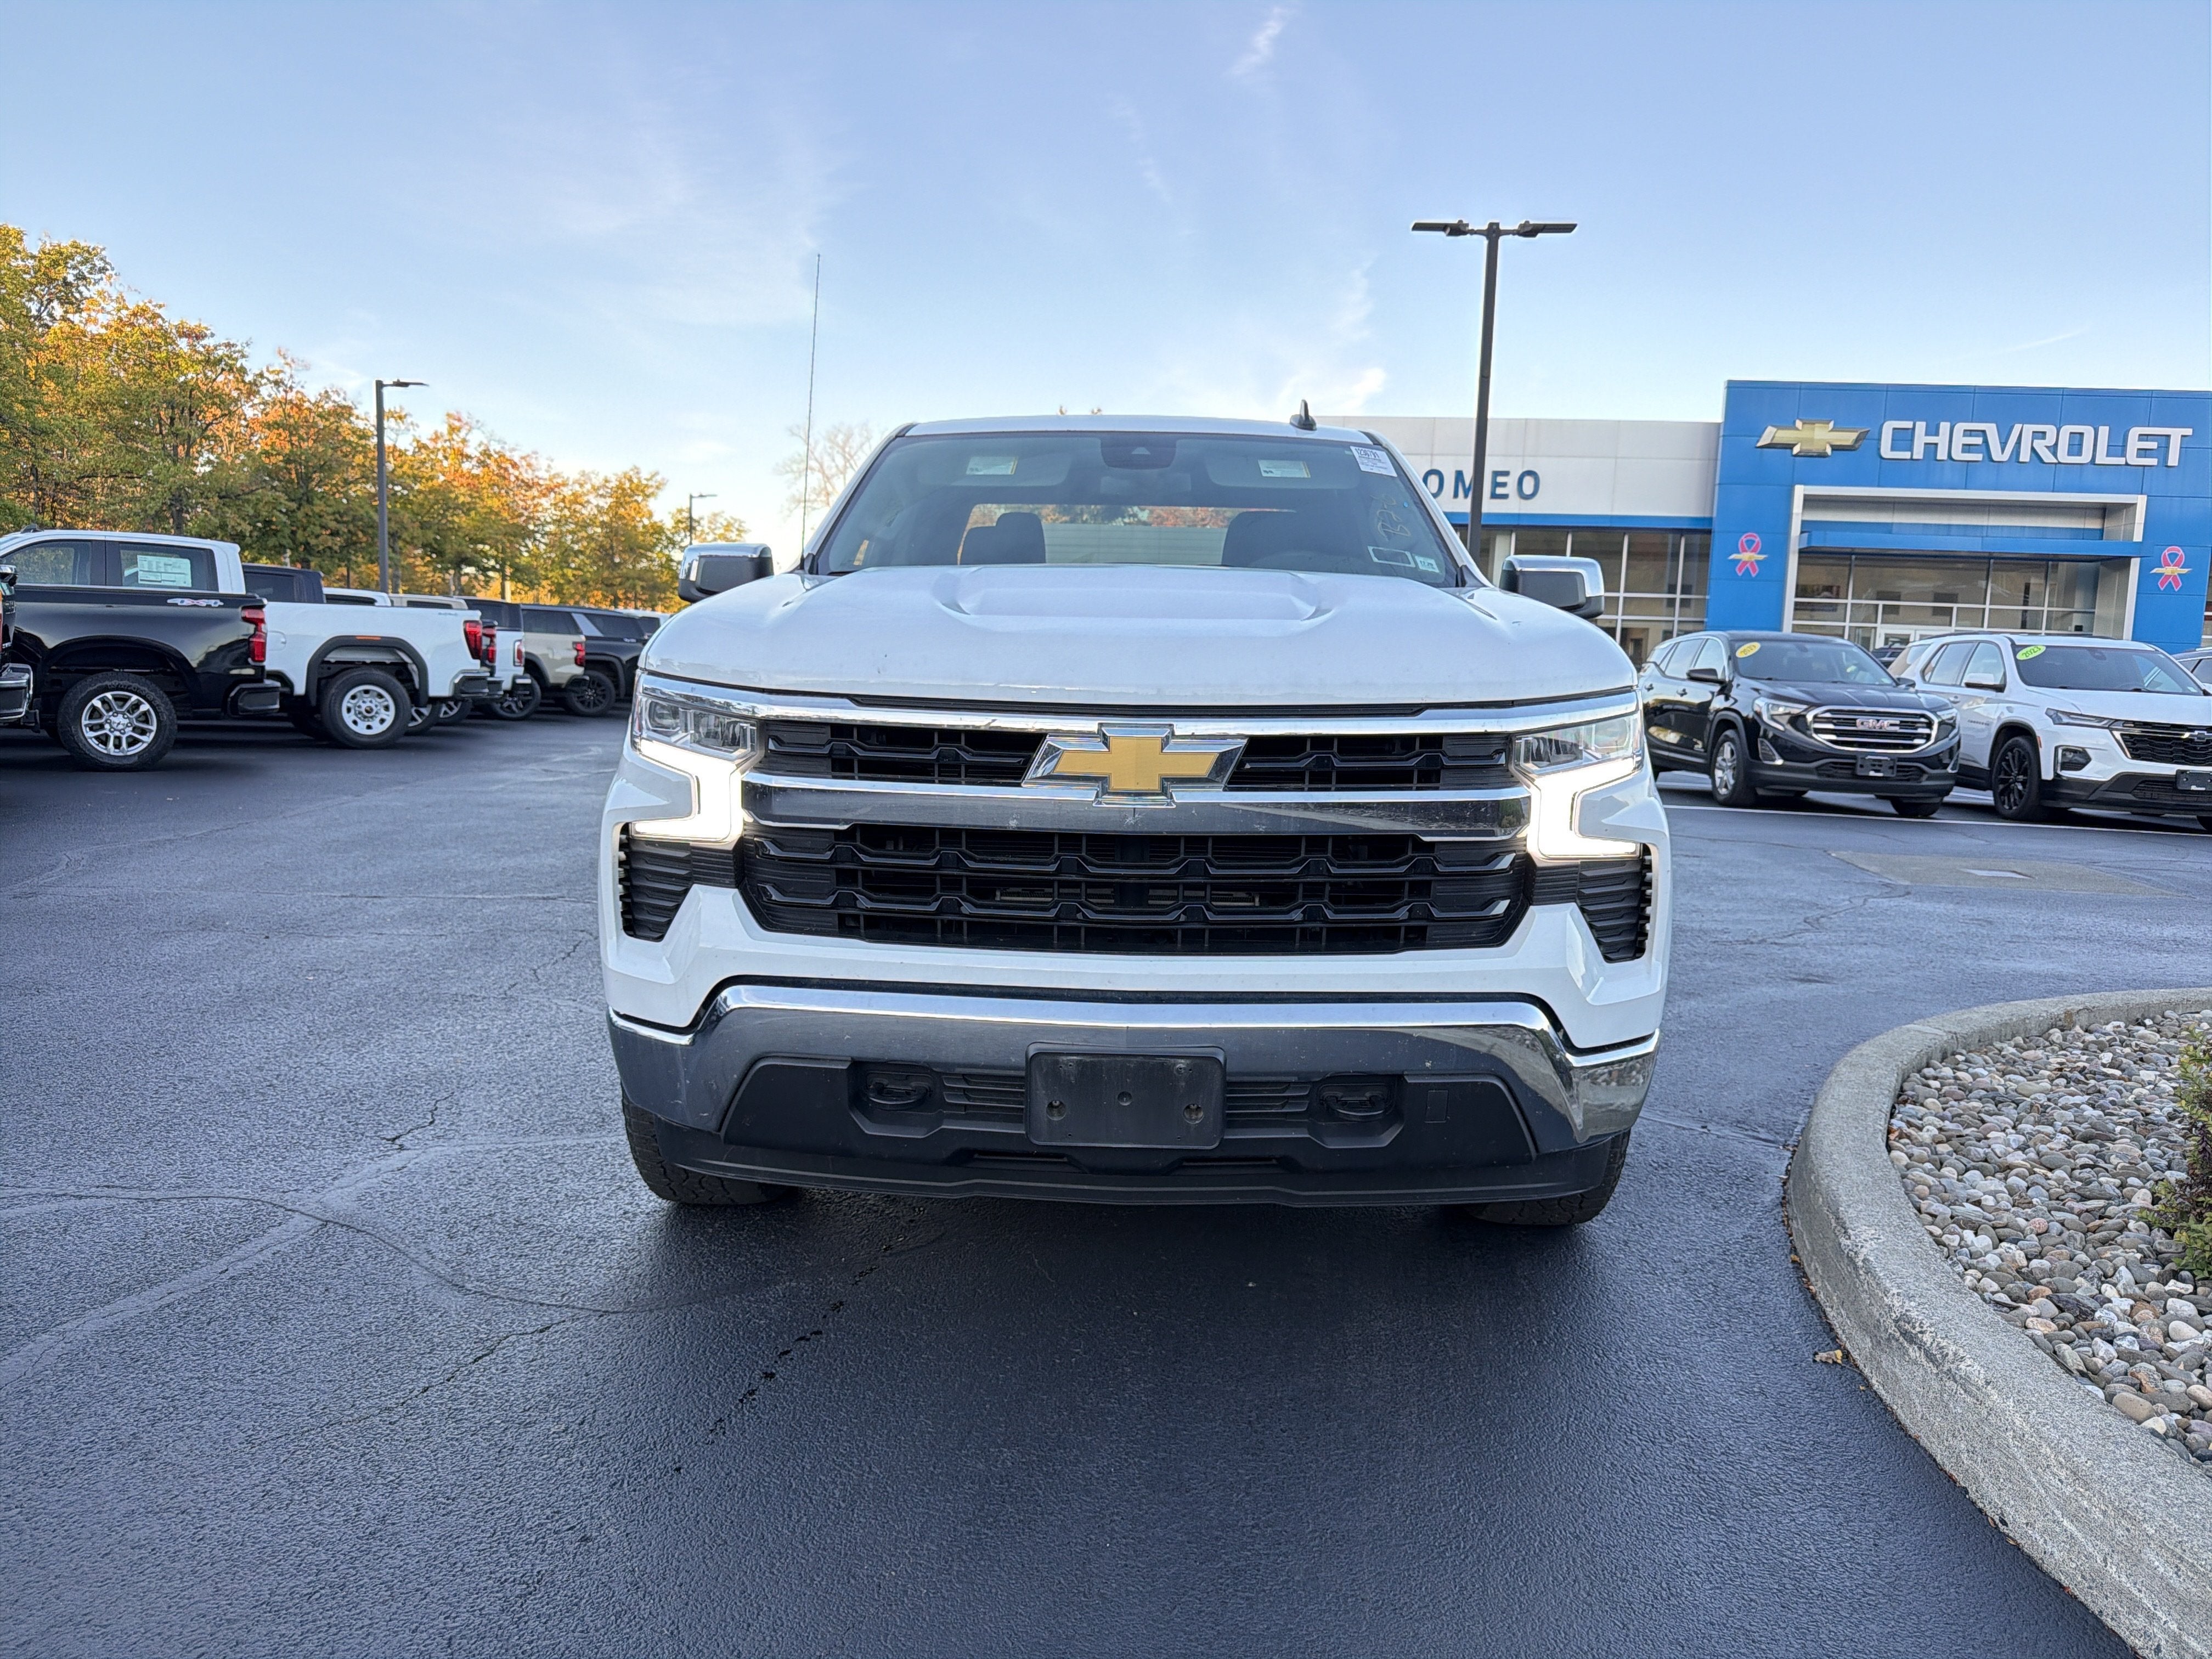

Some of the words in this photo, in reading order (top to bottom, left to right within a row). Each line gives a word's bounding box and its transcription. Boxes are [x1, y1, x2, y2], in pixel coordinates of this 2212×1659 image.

[1880, 420, 2193, 467] CHEVROLET
[2021, 646, 2041, 658] 2023
[1856, 718, 1900, 732] GMC
